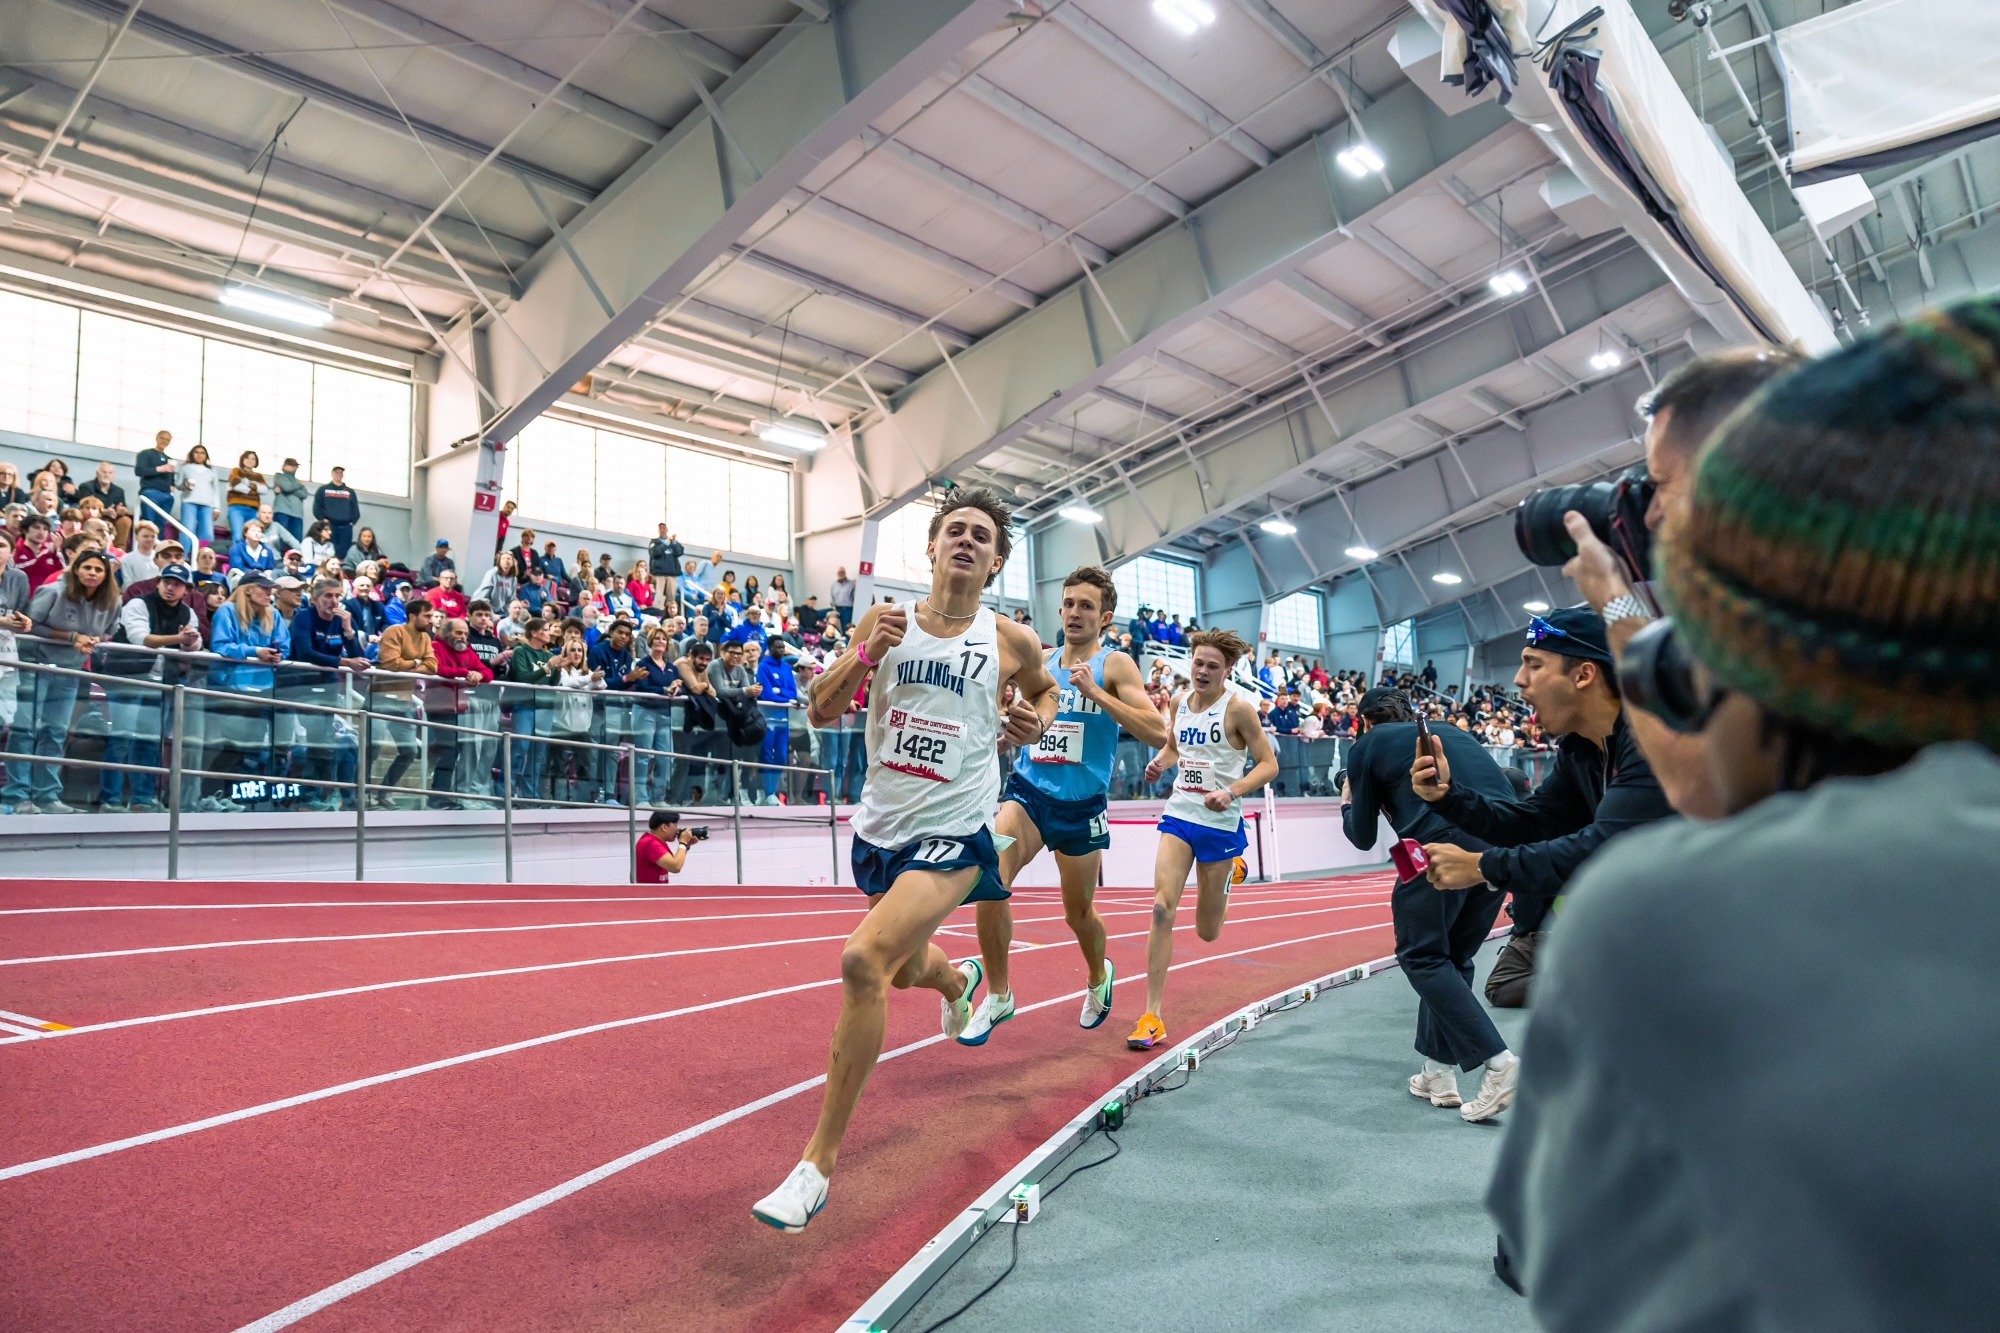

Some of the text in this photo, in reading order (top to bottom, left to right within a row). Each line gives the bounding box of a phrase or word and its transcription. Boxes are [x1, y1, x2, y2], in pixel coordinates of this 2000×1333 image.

[960, 650, 988, 680] 17
[896, 659, 966, 698] VILLANOVA
[889, 709, 908, 728] BU
[1039, 734, 1069, 753] 894
[1179, 727, 1207, 746] BYU
[1210, 721, 1222, 744] 6
[893, 730, 947, 765] 1422
[1184, 769, 1203, 784] 286
[924, 839, 957, 863] 17
